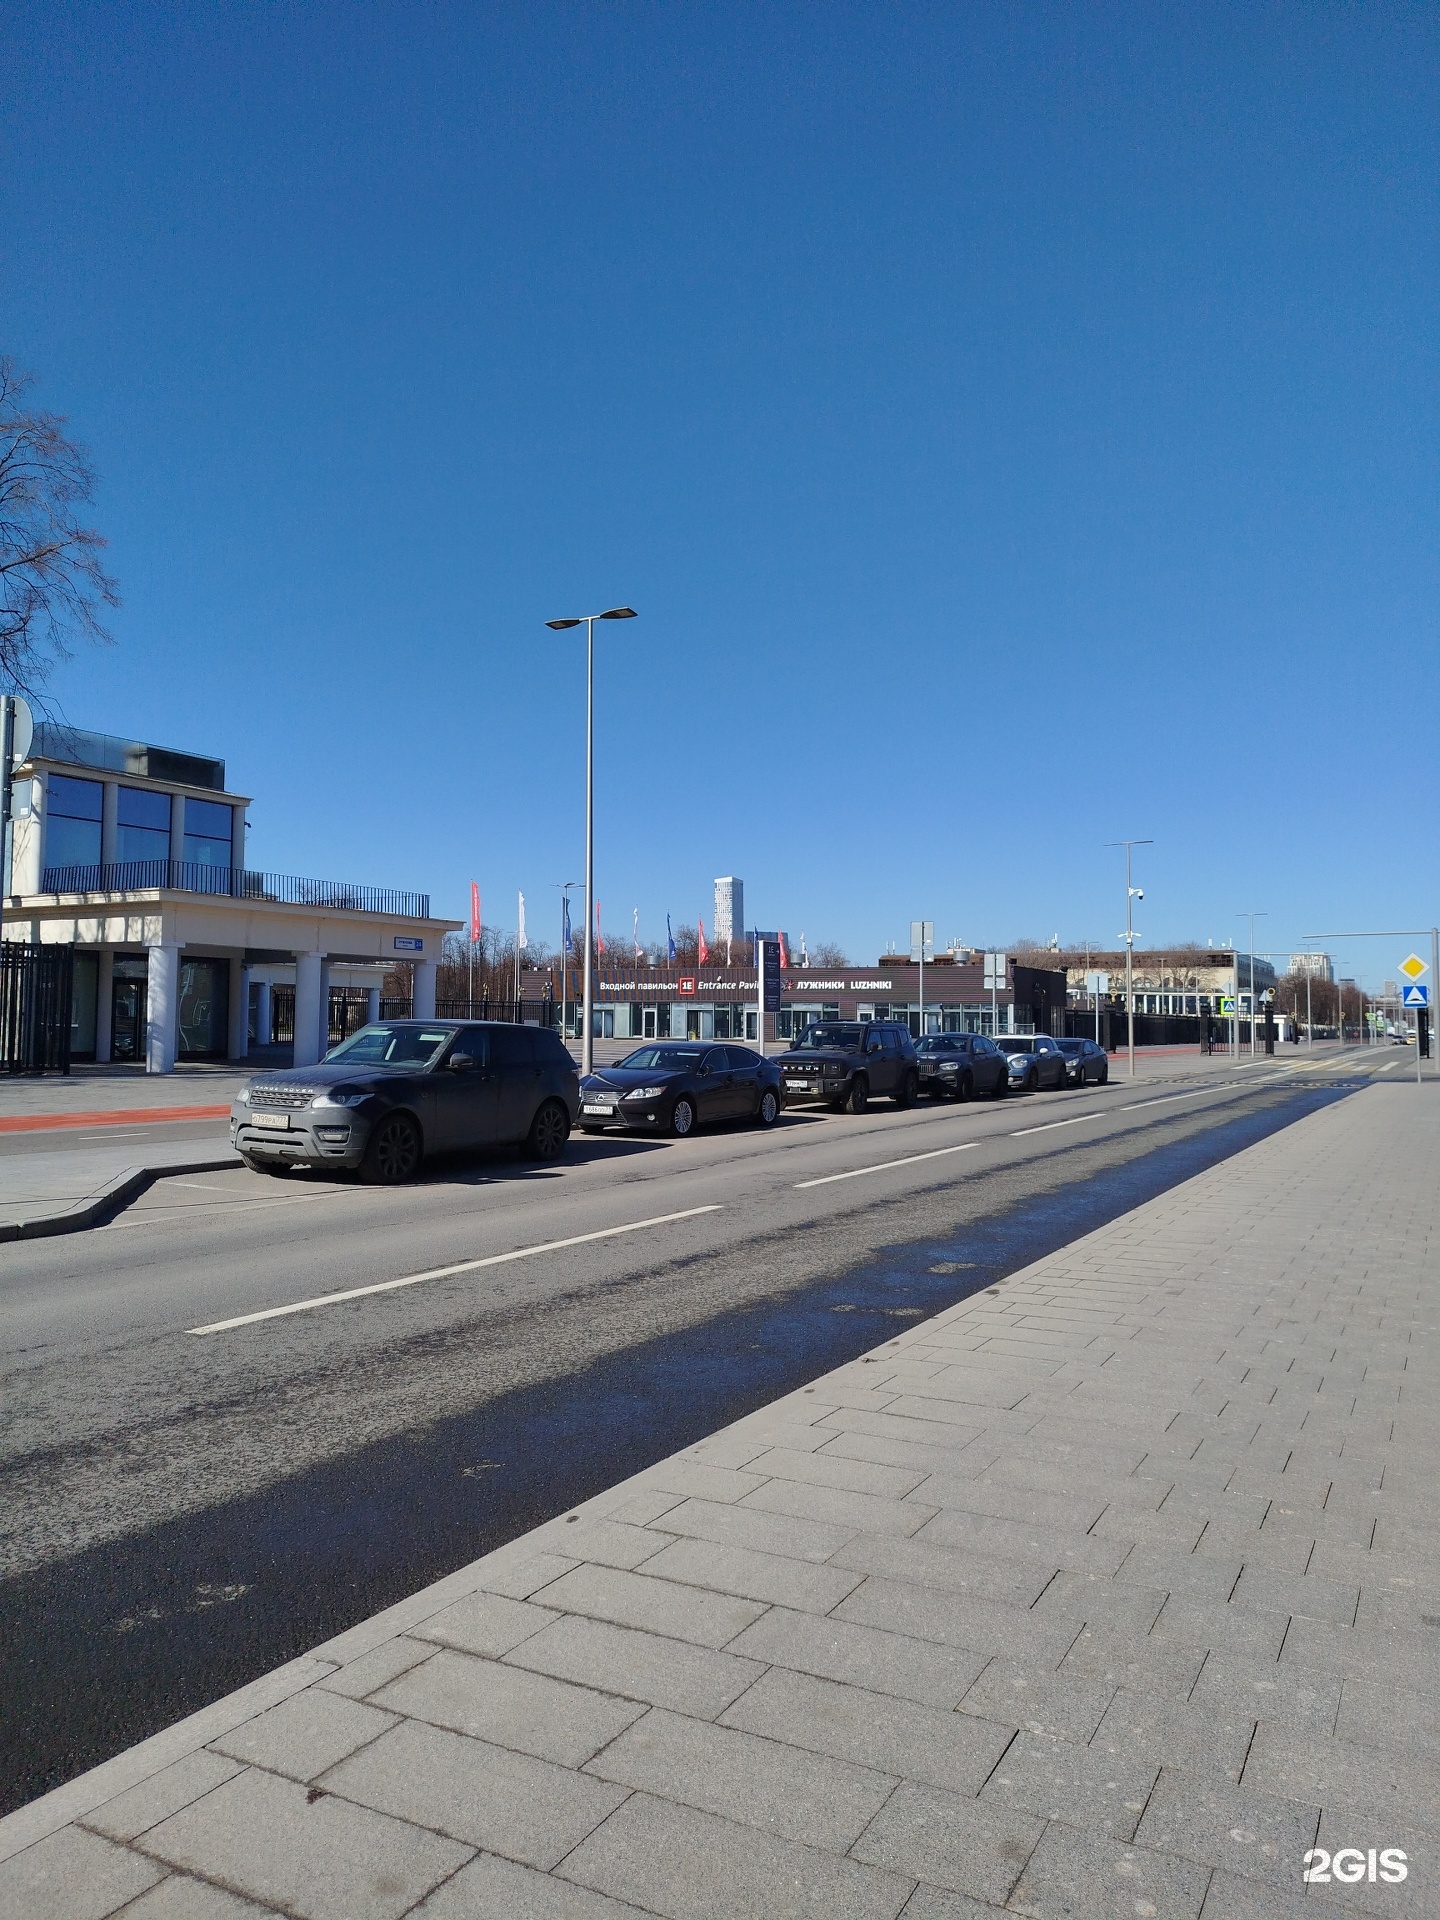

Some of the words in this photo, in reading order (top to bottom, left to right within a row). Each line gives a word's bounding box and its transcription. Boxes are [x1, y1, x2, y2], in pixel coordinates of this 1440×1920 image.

[600, 981, 636, 991] Входной
[638, 982, 678, 990] павильон
[682, 981, 693, 990] 1E
[698, 981, 736, 990] Entrance
[796, 981, 845, 990] ЛУЖНИКИ
[850, 980, 892, 990] LUZHNIKI
